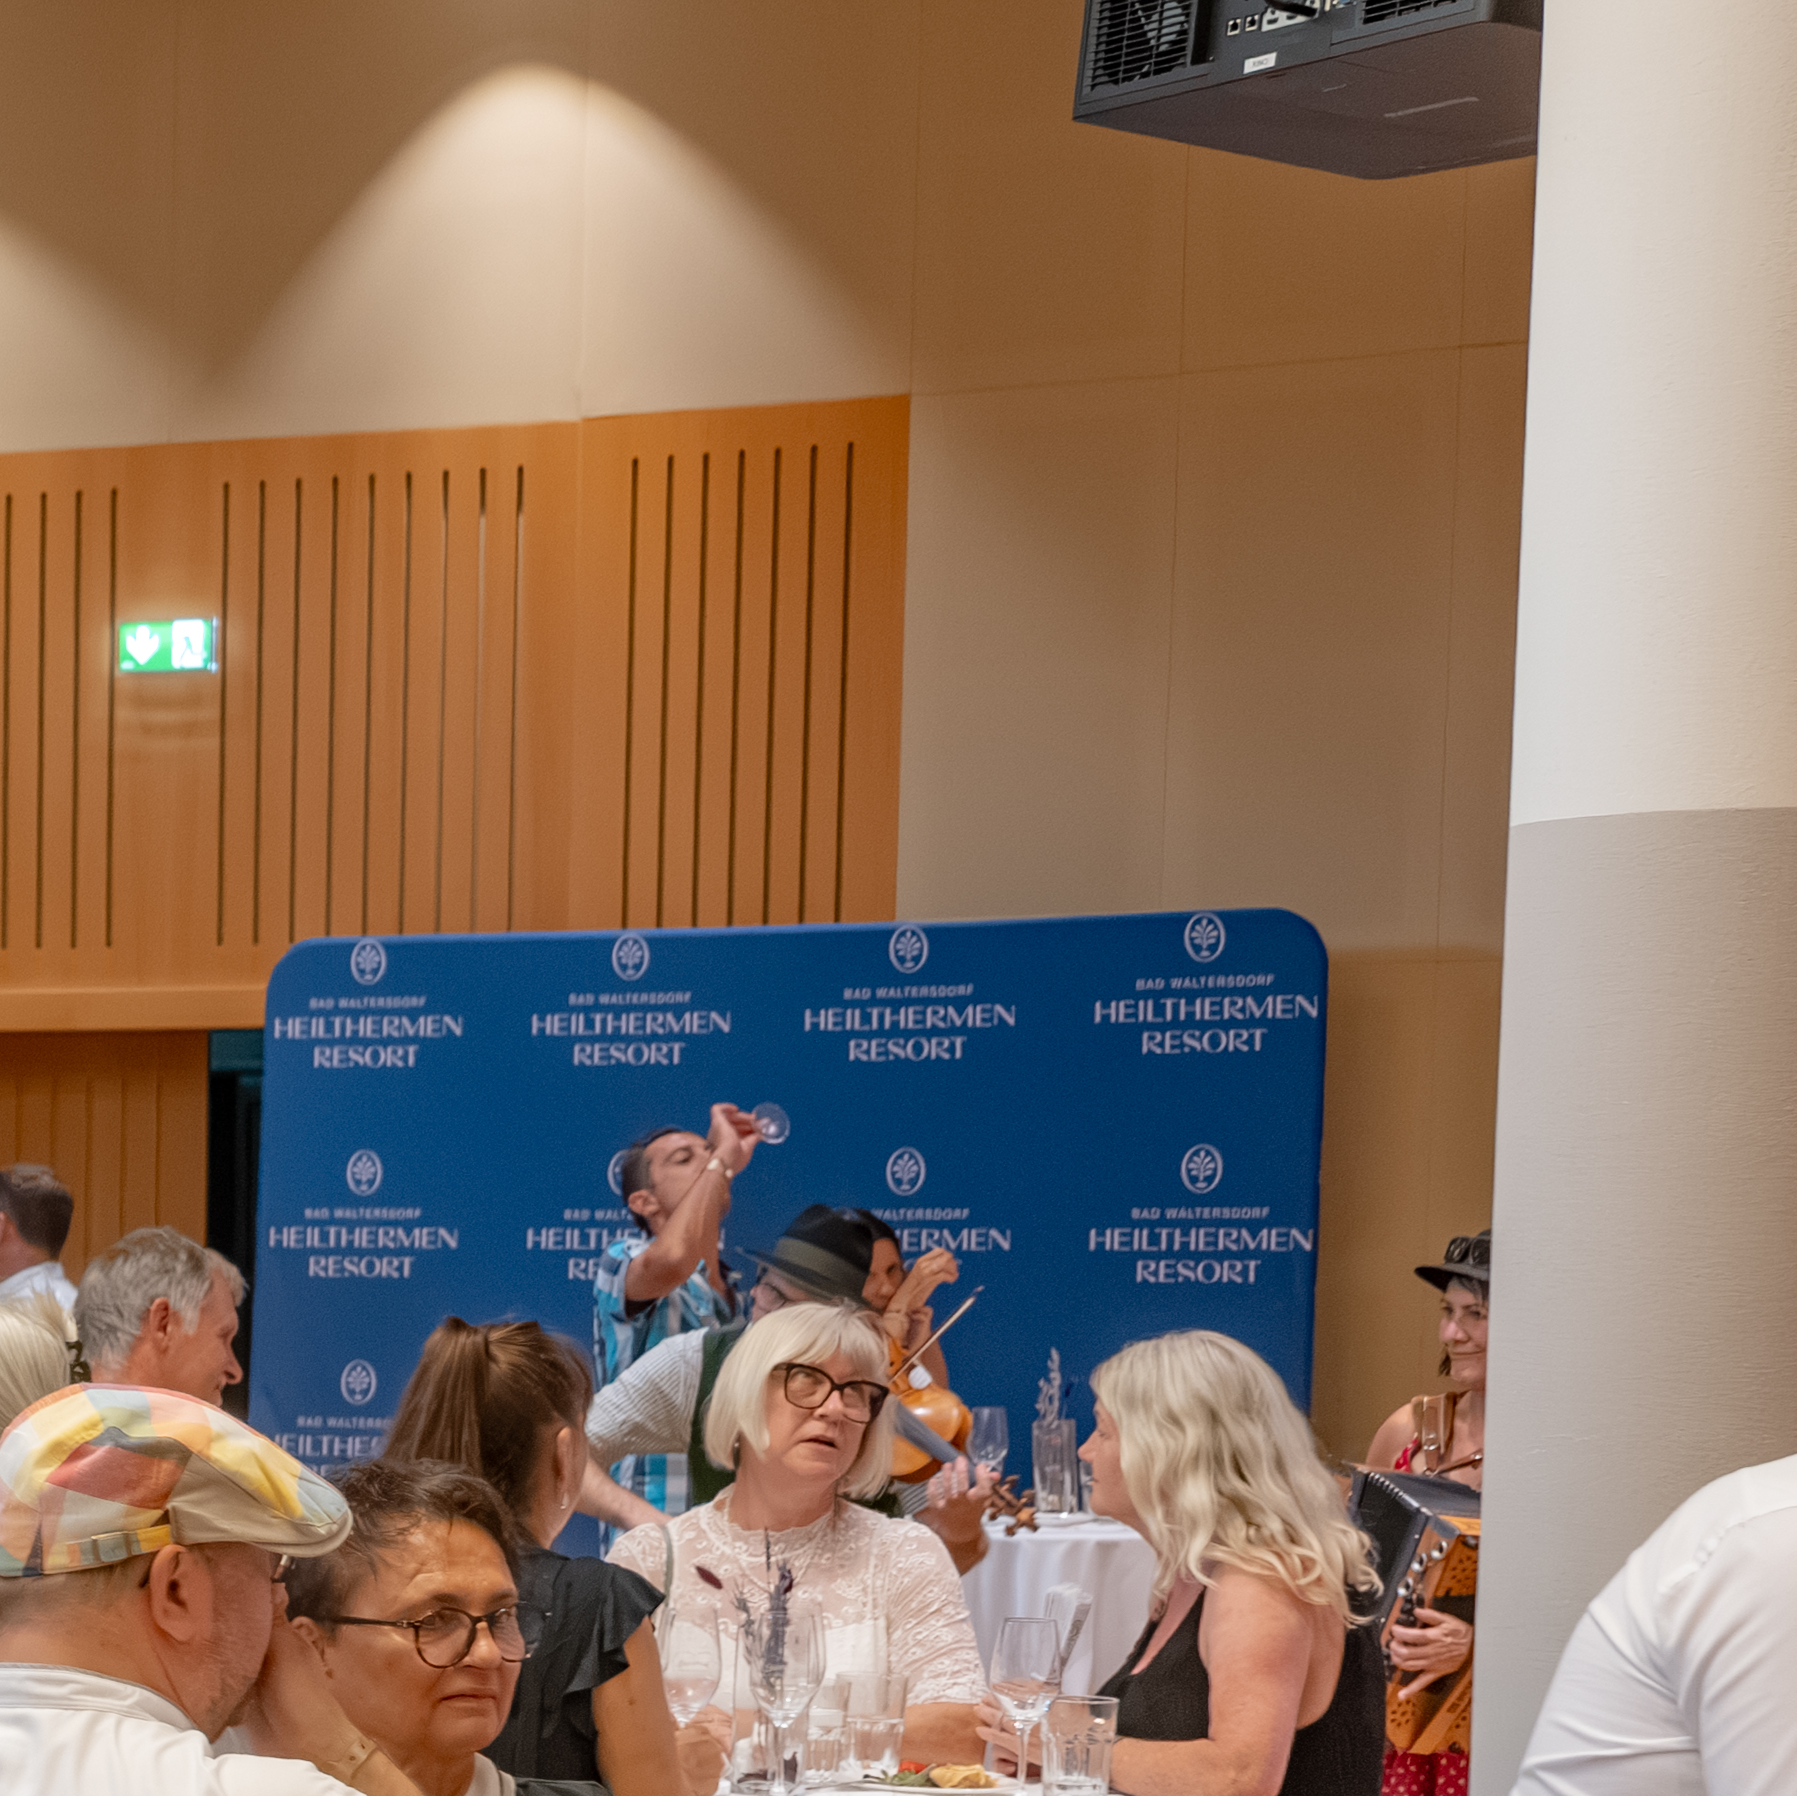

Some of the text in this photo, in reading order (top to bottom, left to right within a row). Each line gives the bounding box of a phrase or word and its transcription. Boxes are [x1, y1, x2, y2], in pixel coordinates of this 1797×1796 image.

[843, 983, 974, 1000] BAD WALTERSDORF
[1136, 973, 1274, 991] BAD WALTERSDORF
[310, 996, 426, 1009] BAD WALTERSDORF
[568, 992, 691, 1006] BAD WALTERSDORF
[1094, 995, 1319, 1024] HEILTHERMEN
[274, 1015, 463, 1039] HEILTHERMEN
[531, 1010, 731, 1036] HEILTHERMEN
[804, 1003, 1016, 1032] HEILTHERMEN
[848, 1035, 967, 1062] RESORT
[1141, 1028, 1268, 1054] RESORT
[313, 1044, 418, 1068] RESORT
[572, 1042, 685, 1067] RESORT
[305, 1207, 422, 1219] BAD WALTERSDORF
[563, 1208, 591, 1221] BAD
[1131, 1206, 1270, 1220] BAD WALTERSDORF
[268, 1226, 459, 1250] HEILTHERMEN
[1088, 1227, 1313, 1252] HEILTHERMEN
[308, 1255, 416, 1279] RESORT
[1136, 1258, 1261, 1284] RESORT
[296, 1416, 323, 1428] BAD
